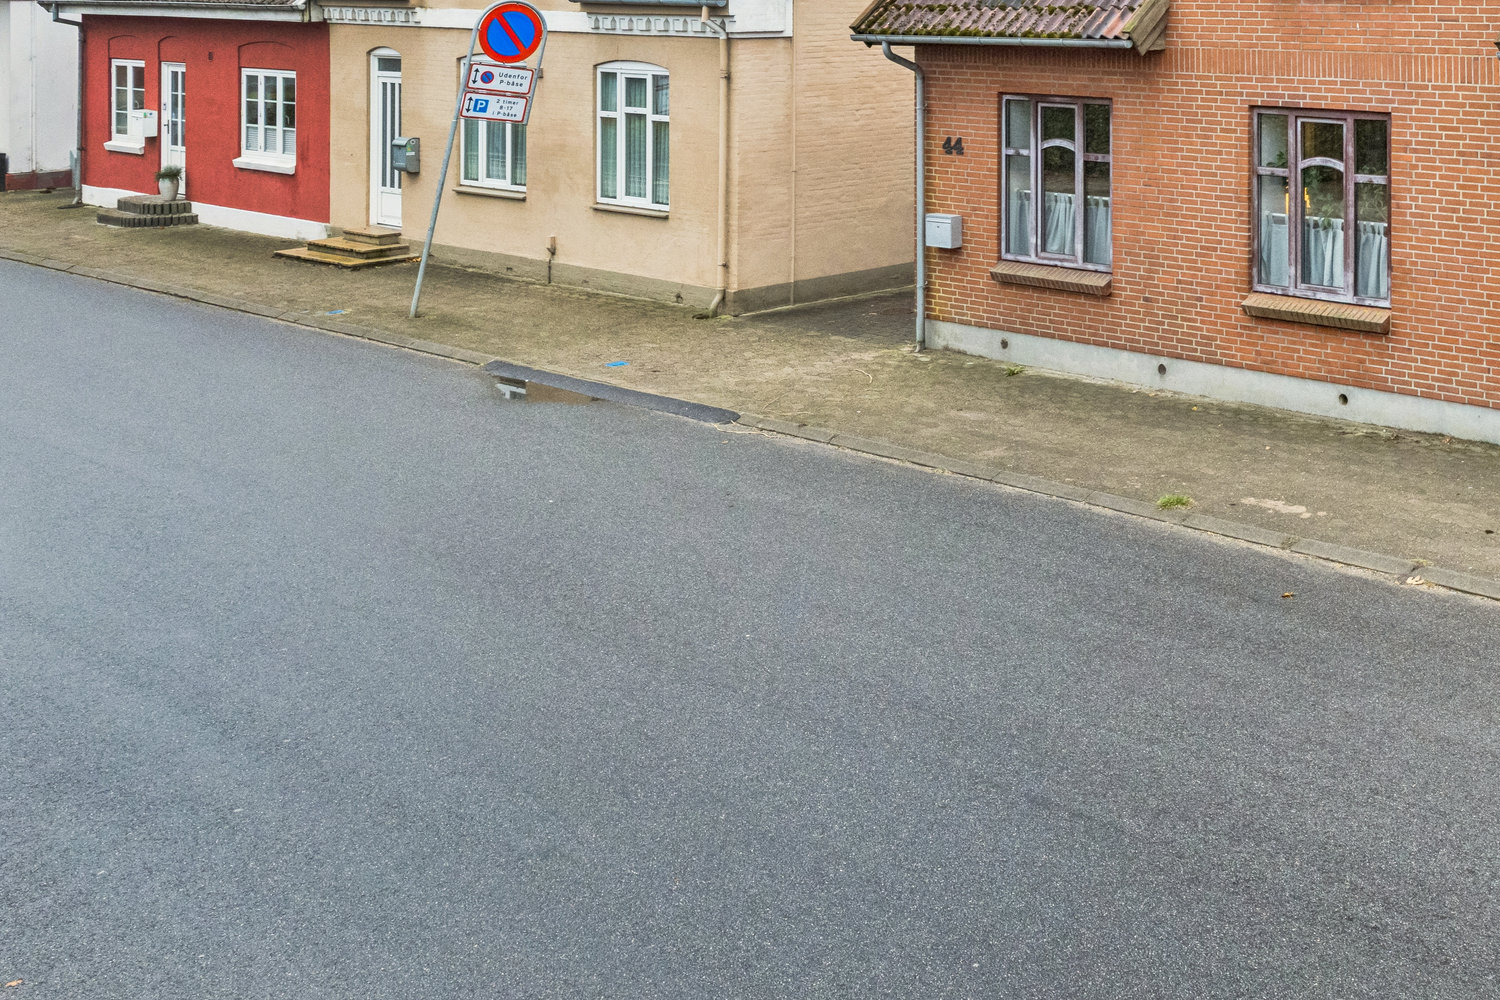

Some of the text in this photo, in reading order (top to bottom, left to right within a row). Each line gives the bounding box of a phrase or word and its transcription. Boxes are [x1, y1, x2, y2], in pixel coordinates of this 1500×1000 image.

[499, 72, 527, 80] Udenfor
[477, 100, 486, 111] P
[942, 136, 964, 155] 44
